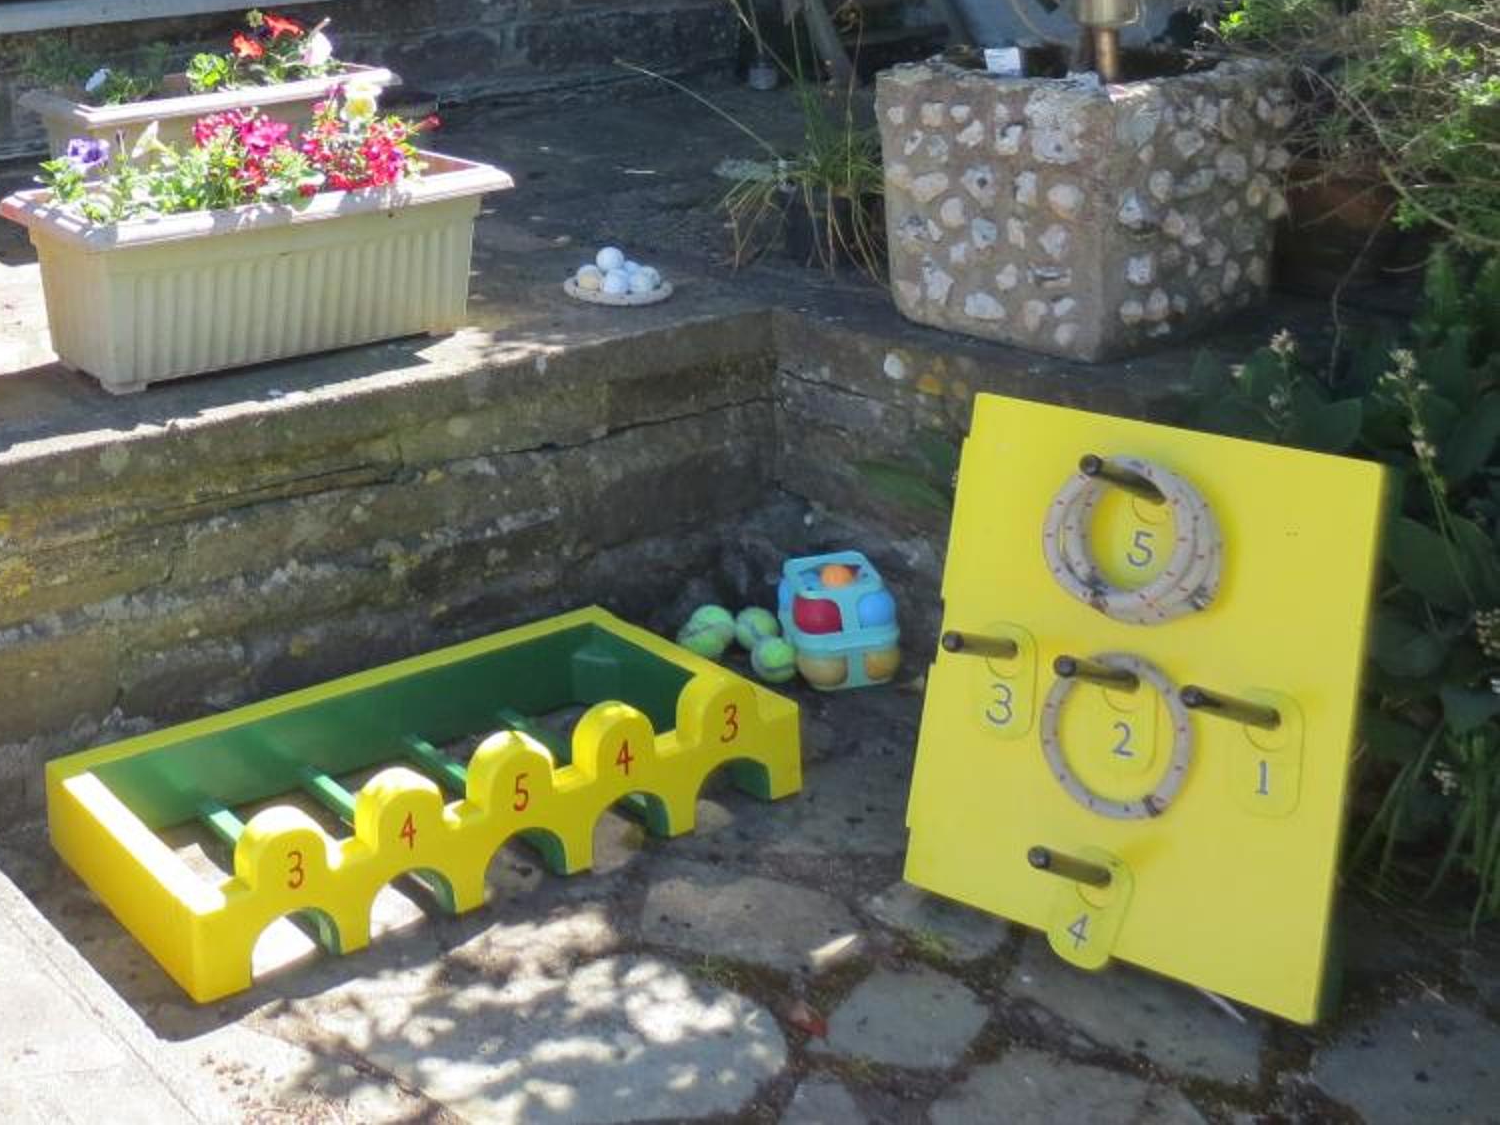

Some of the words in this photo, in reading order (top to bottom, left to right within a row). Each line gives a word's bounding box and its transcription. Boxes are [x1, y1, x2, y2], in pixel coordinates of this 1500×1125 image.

[1126, 530, 1155, 568] 5
[720, 703, 740, 744] 3
[985, 683, 1013, 727] 3
[615, 739, 635, 776] 4
[1112, 722, 1135, 758] 2
[512, 772, 531, 813] 5
[1254, 760, 1270, 796] 1
[399, 811, 417, 851] 4
[287, 850, 305, 890] 3
[1067, 915, 1088, 951] 4
